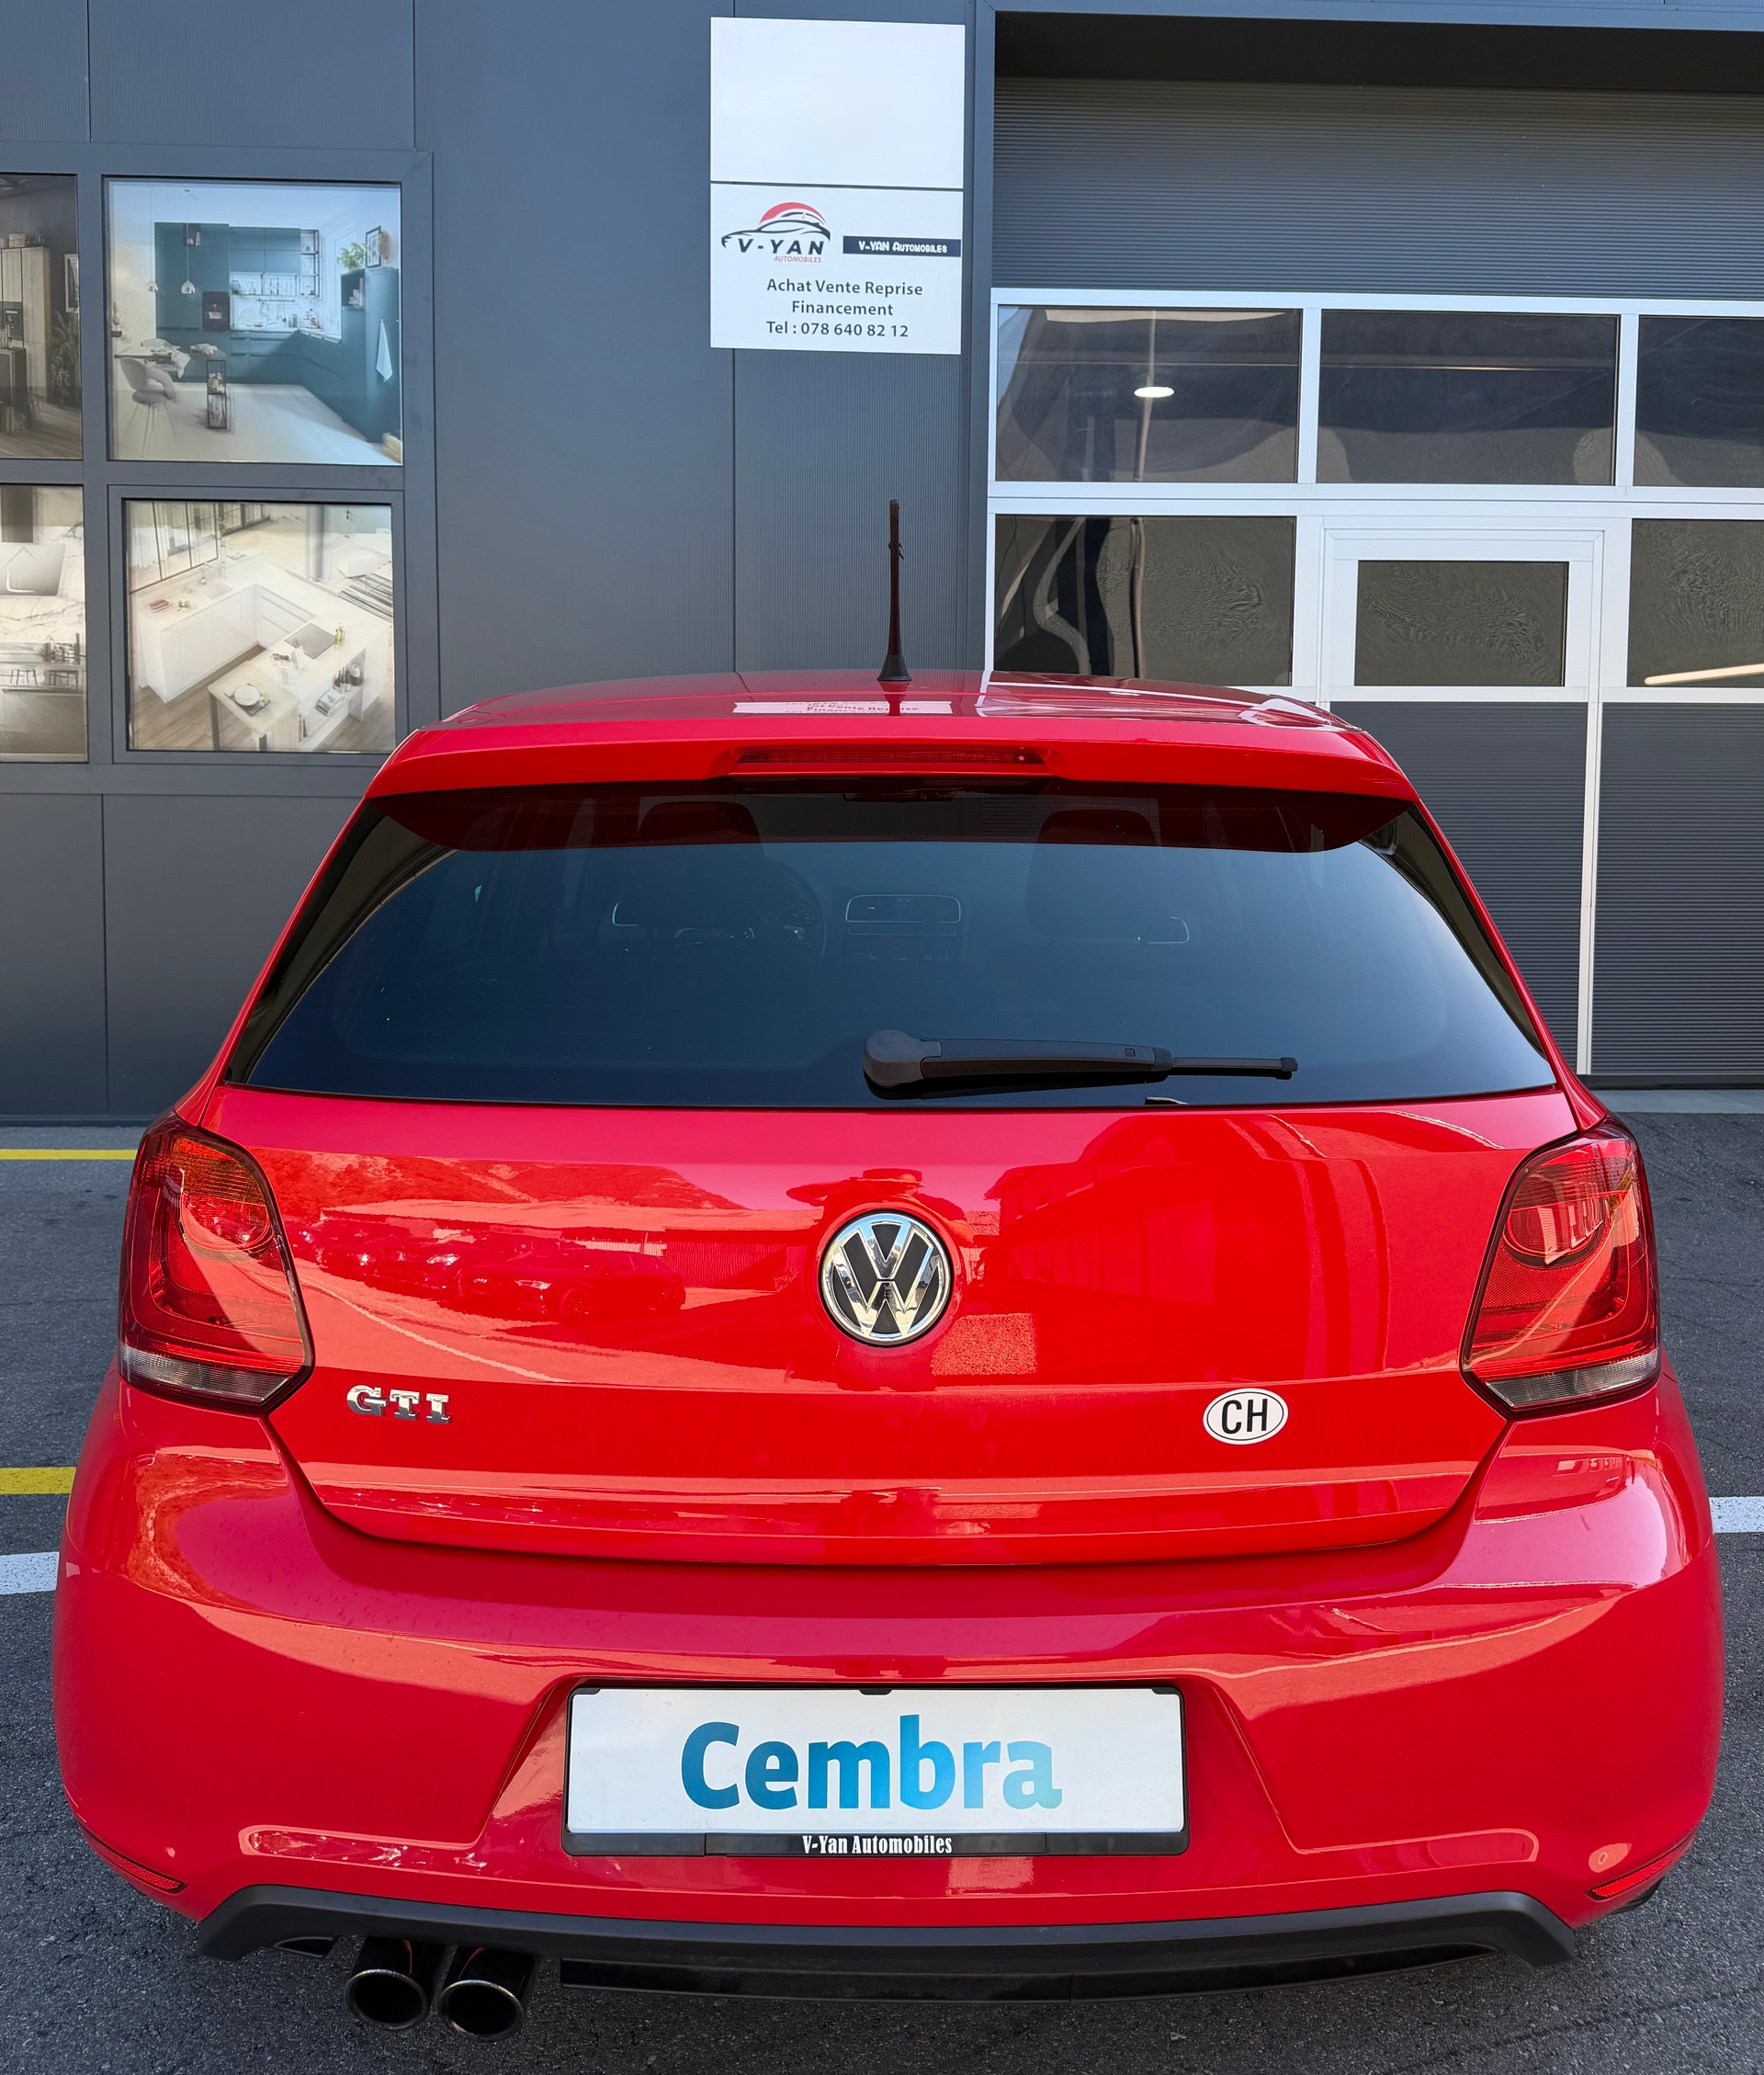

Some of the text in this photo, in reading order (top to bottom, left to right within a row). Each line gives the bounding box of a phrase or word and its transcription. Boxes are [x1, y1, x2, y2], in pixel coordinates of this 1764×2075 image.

[738, 238, 824, 255] V-YAN
[858, 240, 890, 252] V-YAN
[774, 255, 822, 264] AUTOMOBILES
[766, 278, 923, 298] Achat Vente Reprise
[792, 300, 894, 315] Financement
[800, 323, 830, 335] 078
[833, 323, 863, 336] 640
[866, 324, 886, 337] 82
[891, 324, 909, 337] 12
[346, 1384, 453, 1423] GTI
[1221, 1398, 1268, 1434] CH
[681, 1714, 1063, 1810] Cembra
[802, 1835, 953, 1854] V-Yan Automobiles
